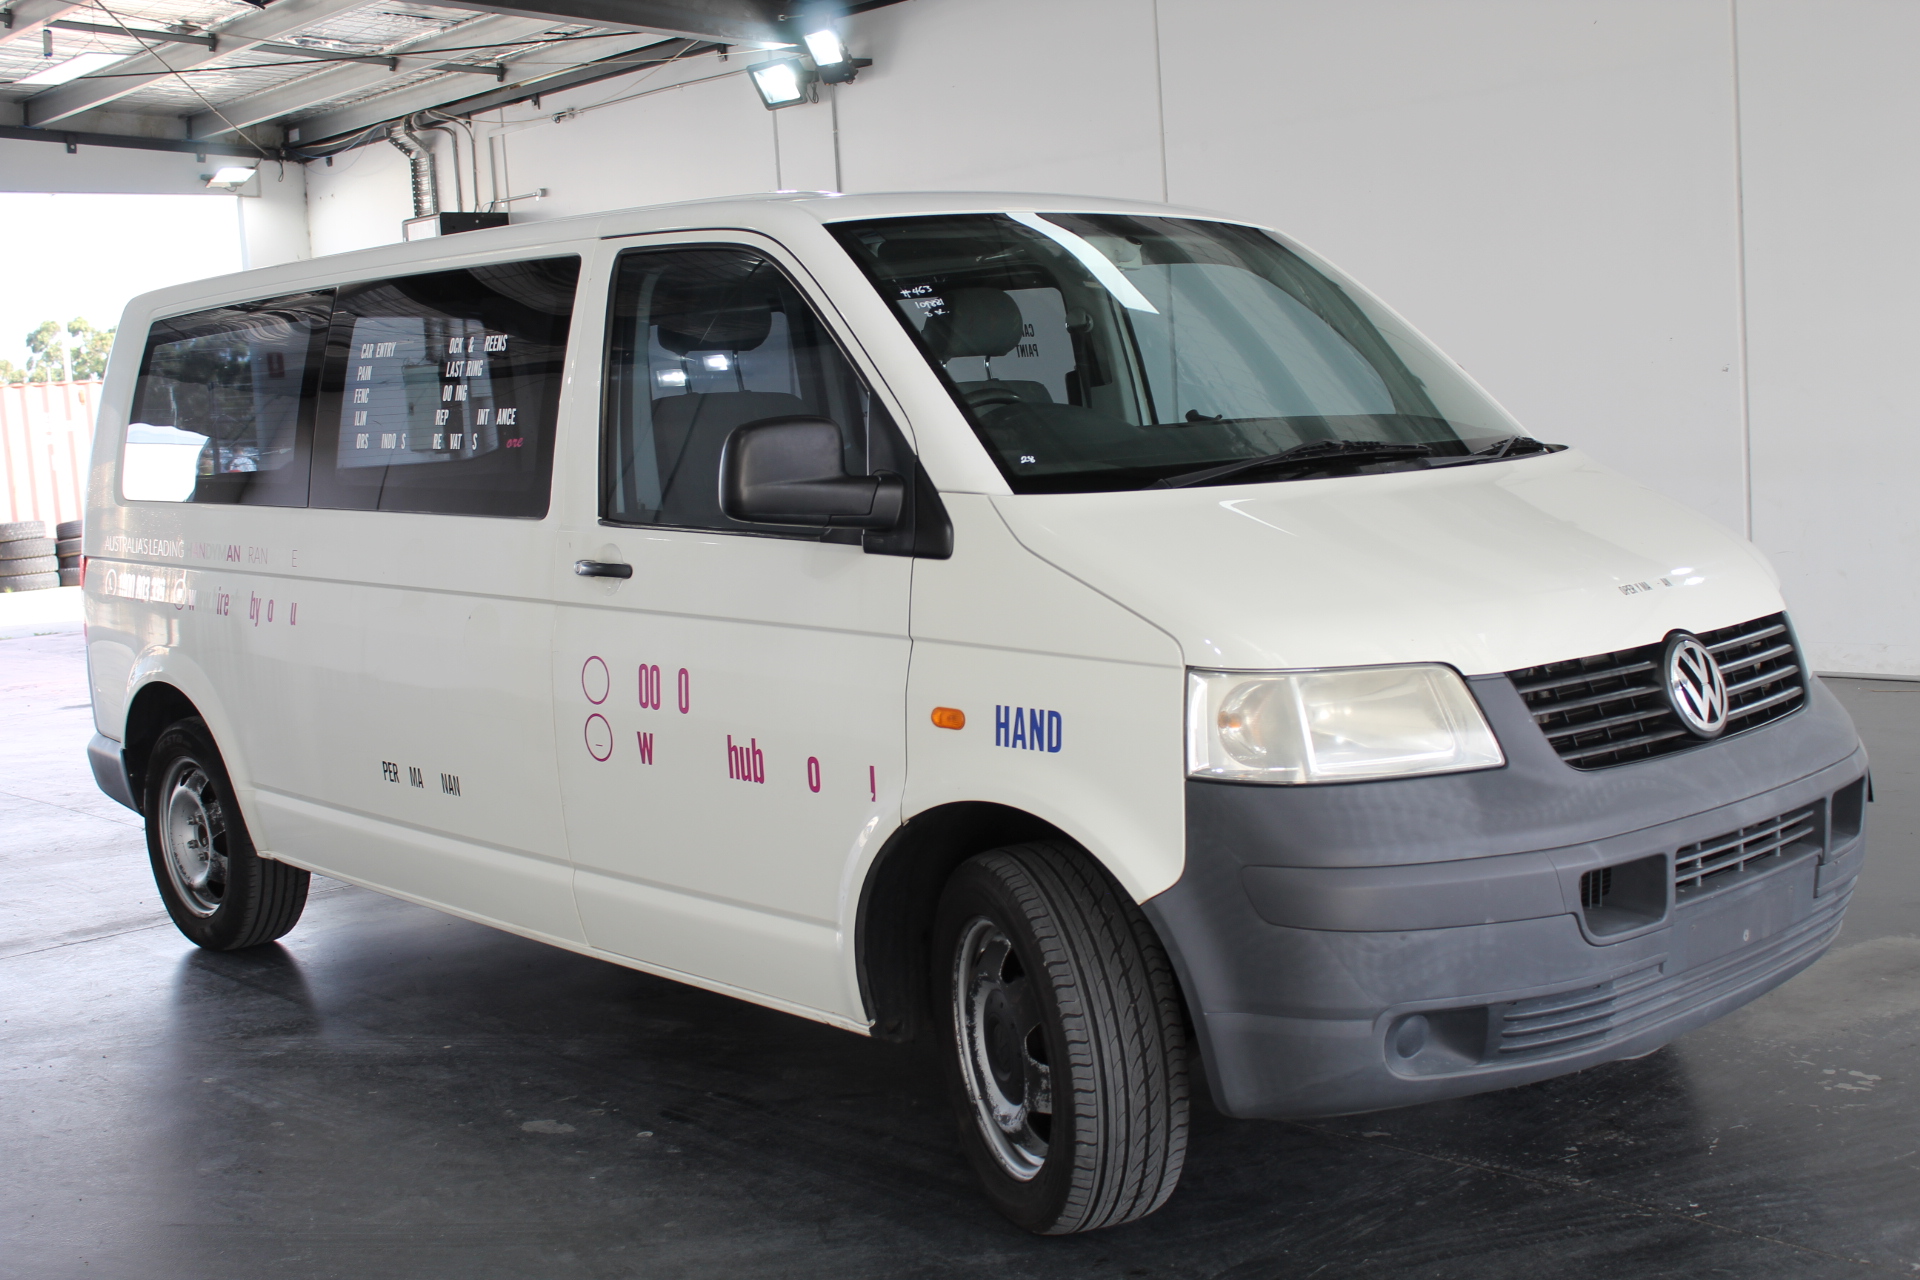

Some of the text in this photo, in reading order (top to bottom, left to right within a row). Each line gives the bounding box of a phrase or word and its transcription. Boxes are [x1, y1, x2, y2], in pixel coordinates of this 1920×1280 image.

[361, 342, 397, 359] CAR ENTRY
[468, 336, 475, 353] &
[484, 334, 508, 352] REENS
[357, 365, 373, 381] PAIN
[446, 360, 484, 377] LAST RING
[353, 388, 370, 403] FENC
[435, 408, 517, 425] REP INT ANCE
[149, 539, 184, 558] LEADING
[995, 704, 1062, 754] HAND
[726, 734, 765, 785] hub
[382, 760, 461, 797] PER MA NAN
